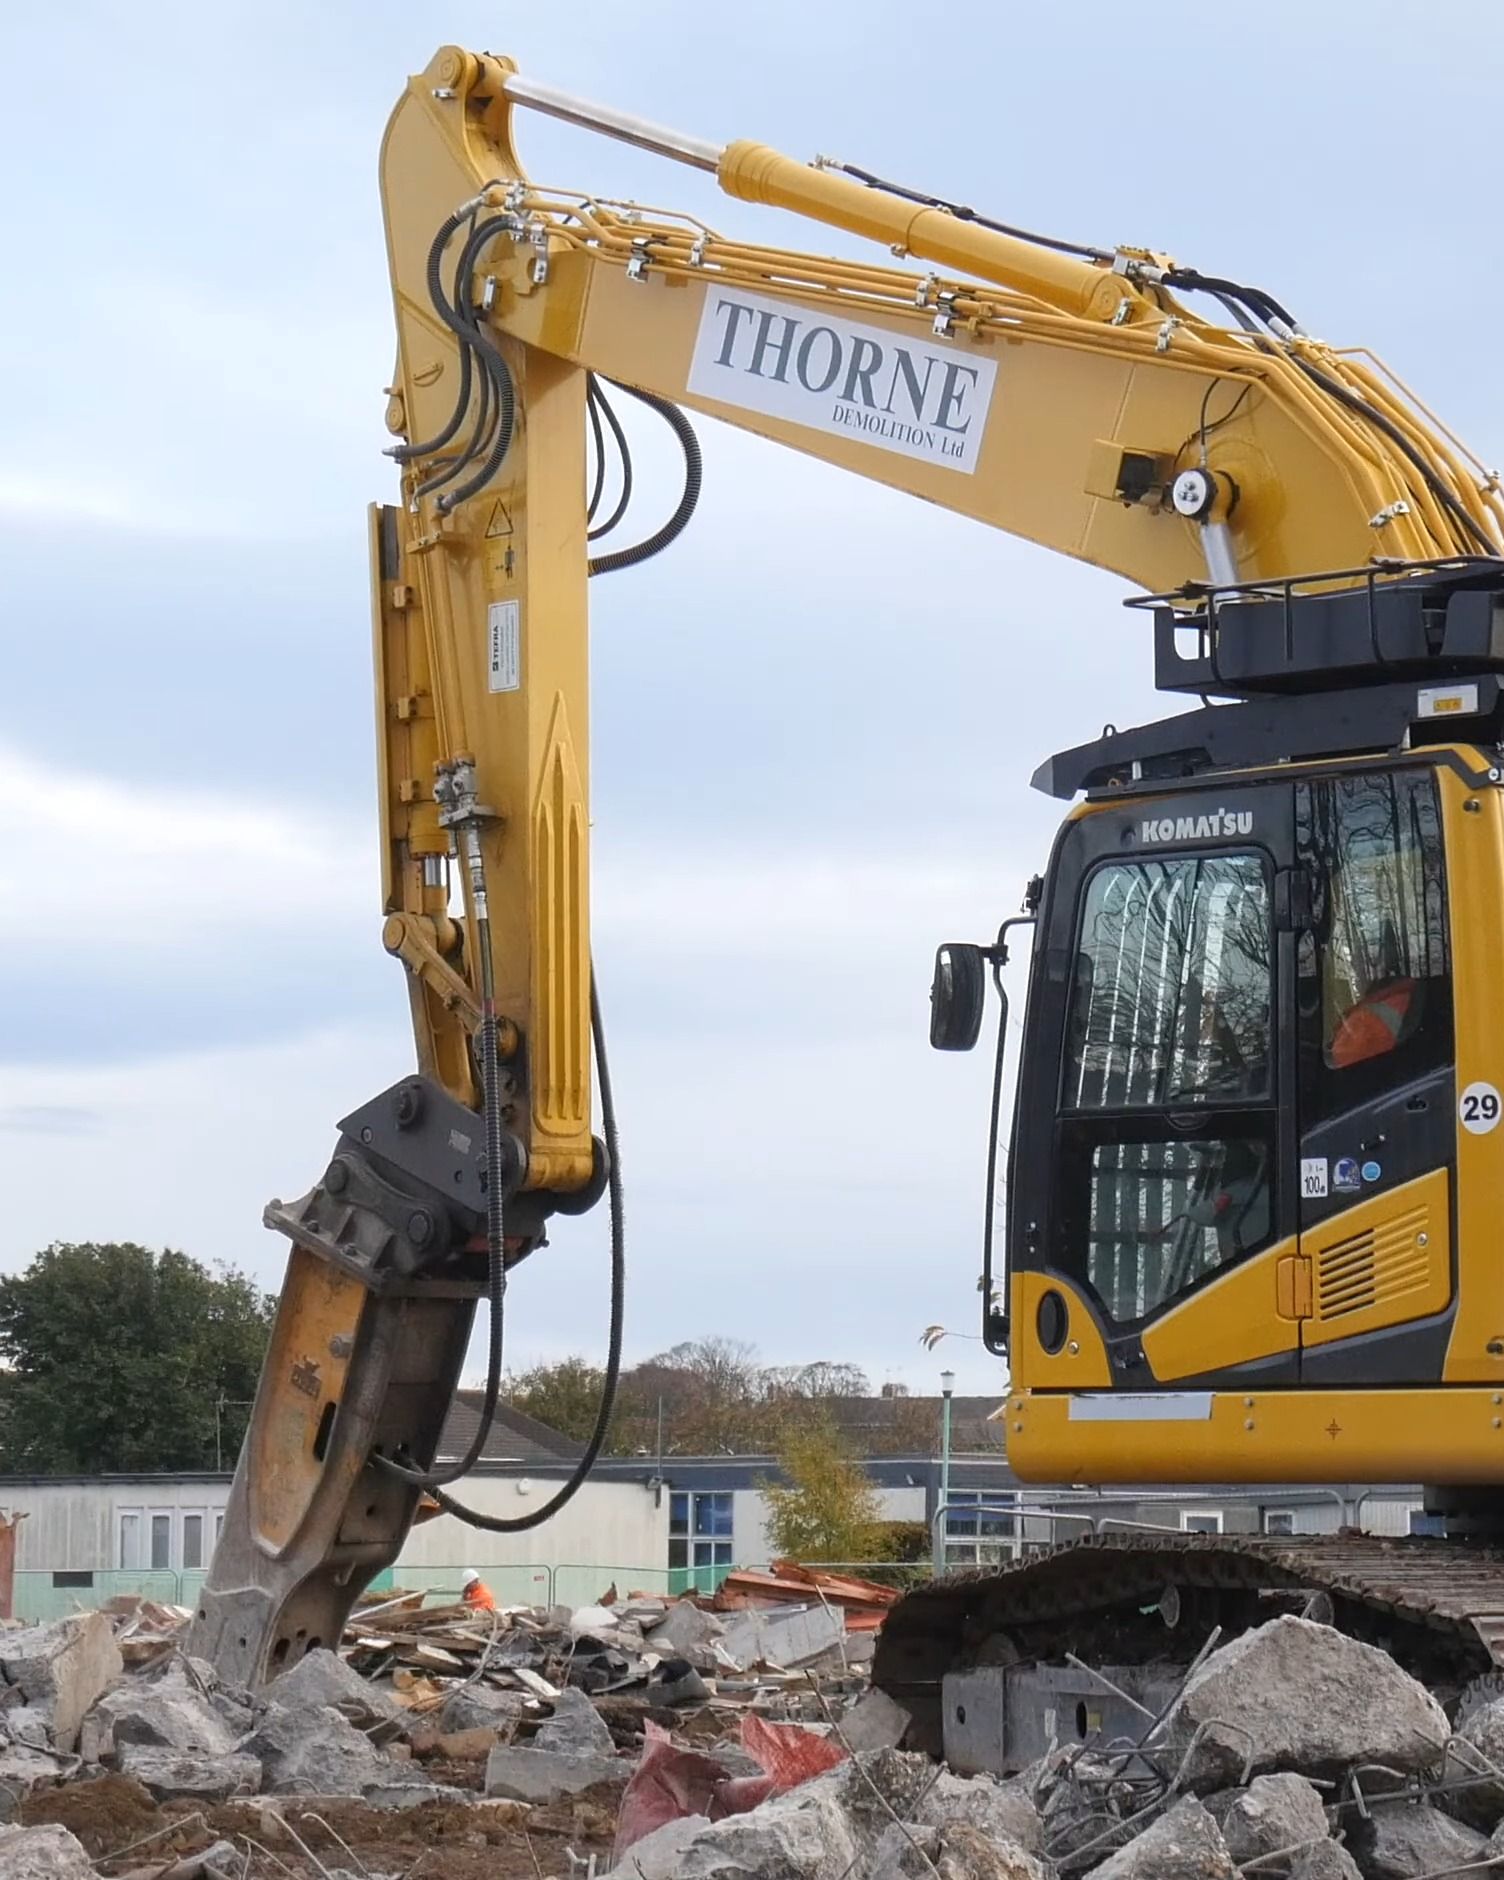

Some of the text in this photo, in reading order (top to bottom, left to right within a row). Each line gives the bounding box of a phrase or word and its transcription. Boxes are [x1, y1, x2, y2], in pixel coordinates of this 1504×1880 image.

[713, 299, 979, 435] THORNE
[831, 404, 966, 459] DEMOLITION Ltd
[1141, 807, 1253, 843] KOMATSU
[1463, 1093, 1499, 1122] 29
